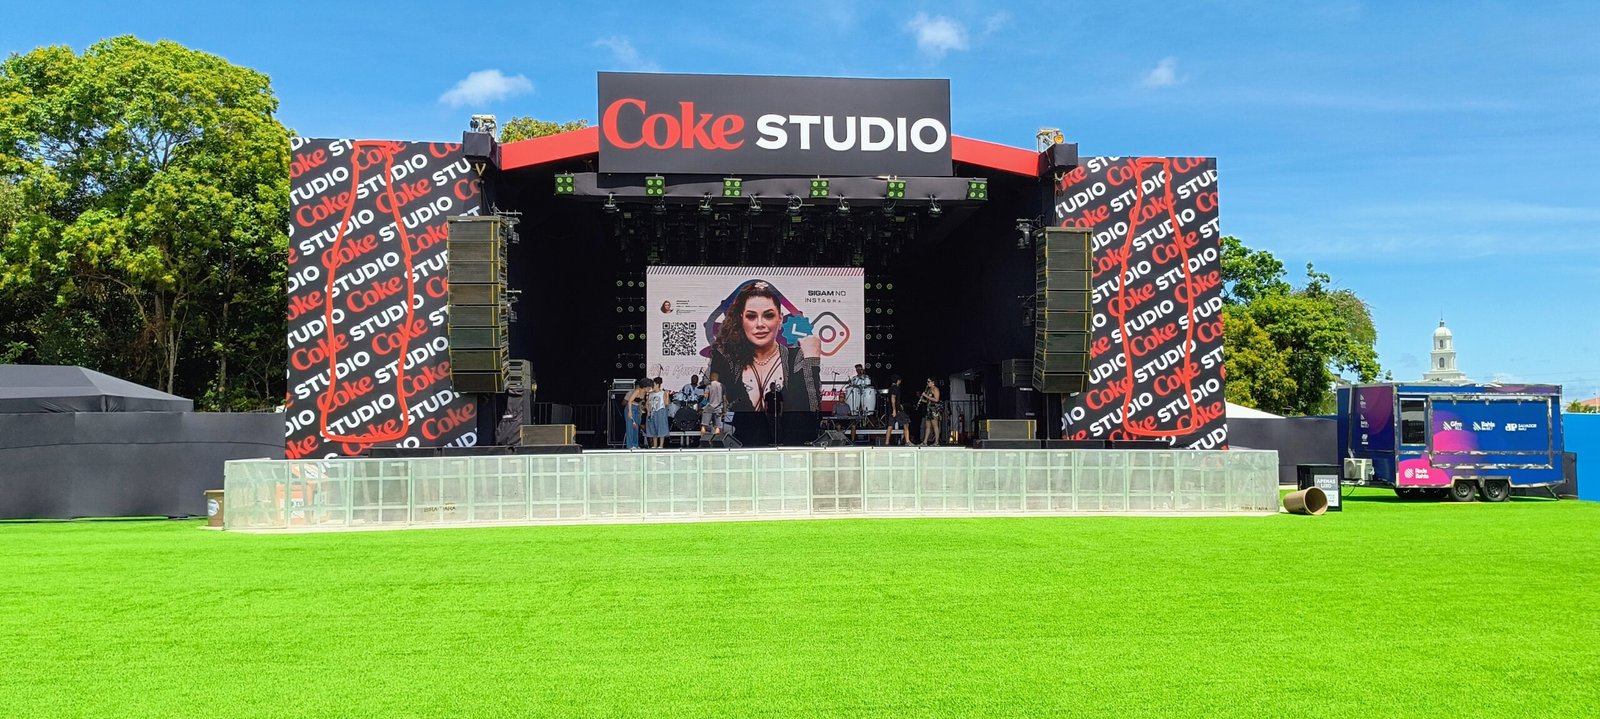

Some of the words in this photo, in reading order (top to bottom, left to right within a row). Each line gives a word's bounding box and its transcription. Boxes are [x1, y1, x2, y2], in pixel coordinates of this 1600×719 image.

[602, 98, 744, 150] Coke
[756, 114, 947, 153] STUDIO
[296, 191, 352, 228] Coke
[356, 154, 428, 200] STUDIO
[300, 209, 374, 256] STUDIO
[376, 178, 432, 214] Coke
[1110, 170, 1173, 213] STUDIO
[1128, 192, 1176, 226] Coke
[321, 234, 378, 270] Coke
[379, 196, 453, 242] STUDIO
[1132, 208, 1196, 252] STUDIO
[324, 252, 400, 299] STUDIO
[346, 276, 403, 313] Coke
[1092, 260, 1152, 304] STUDIO
[1152, 231, 1200, 265] Coke
[1108, 282, 1156, 317] Coke
[1156, 247, 1218, 291] STUDIO
[291, 332, 349, 371] Coke
[350, 294, 425, 342] STUDIO
[1110, 300, 1174, 344] STUDIO
[1174, 270, 1222, 304] Coke
[1130, 322, 1178, 357] Coke
[294, 351, 370, 400] STUDIO
[372, 318, 428, 356] Coke
[316, 376, 374, 414] Coke
[374, 336, 449, 384] STUDIO
[1086, 376, 1133, 410] Coke
[1134, 339, 1197, 384] STUDIO
[320, 393, 396, 444] STUDIO
[400, 360, 451, 398] Coke
[422, 402, 478, 440] Coke
[1089, 392, 1153, 437] STUDIO
[1153, 361, 1201, 396] Coke
[1157, 378, 1220, 423] STUDIO
[1176, 401, 1225, 434] Coke
